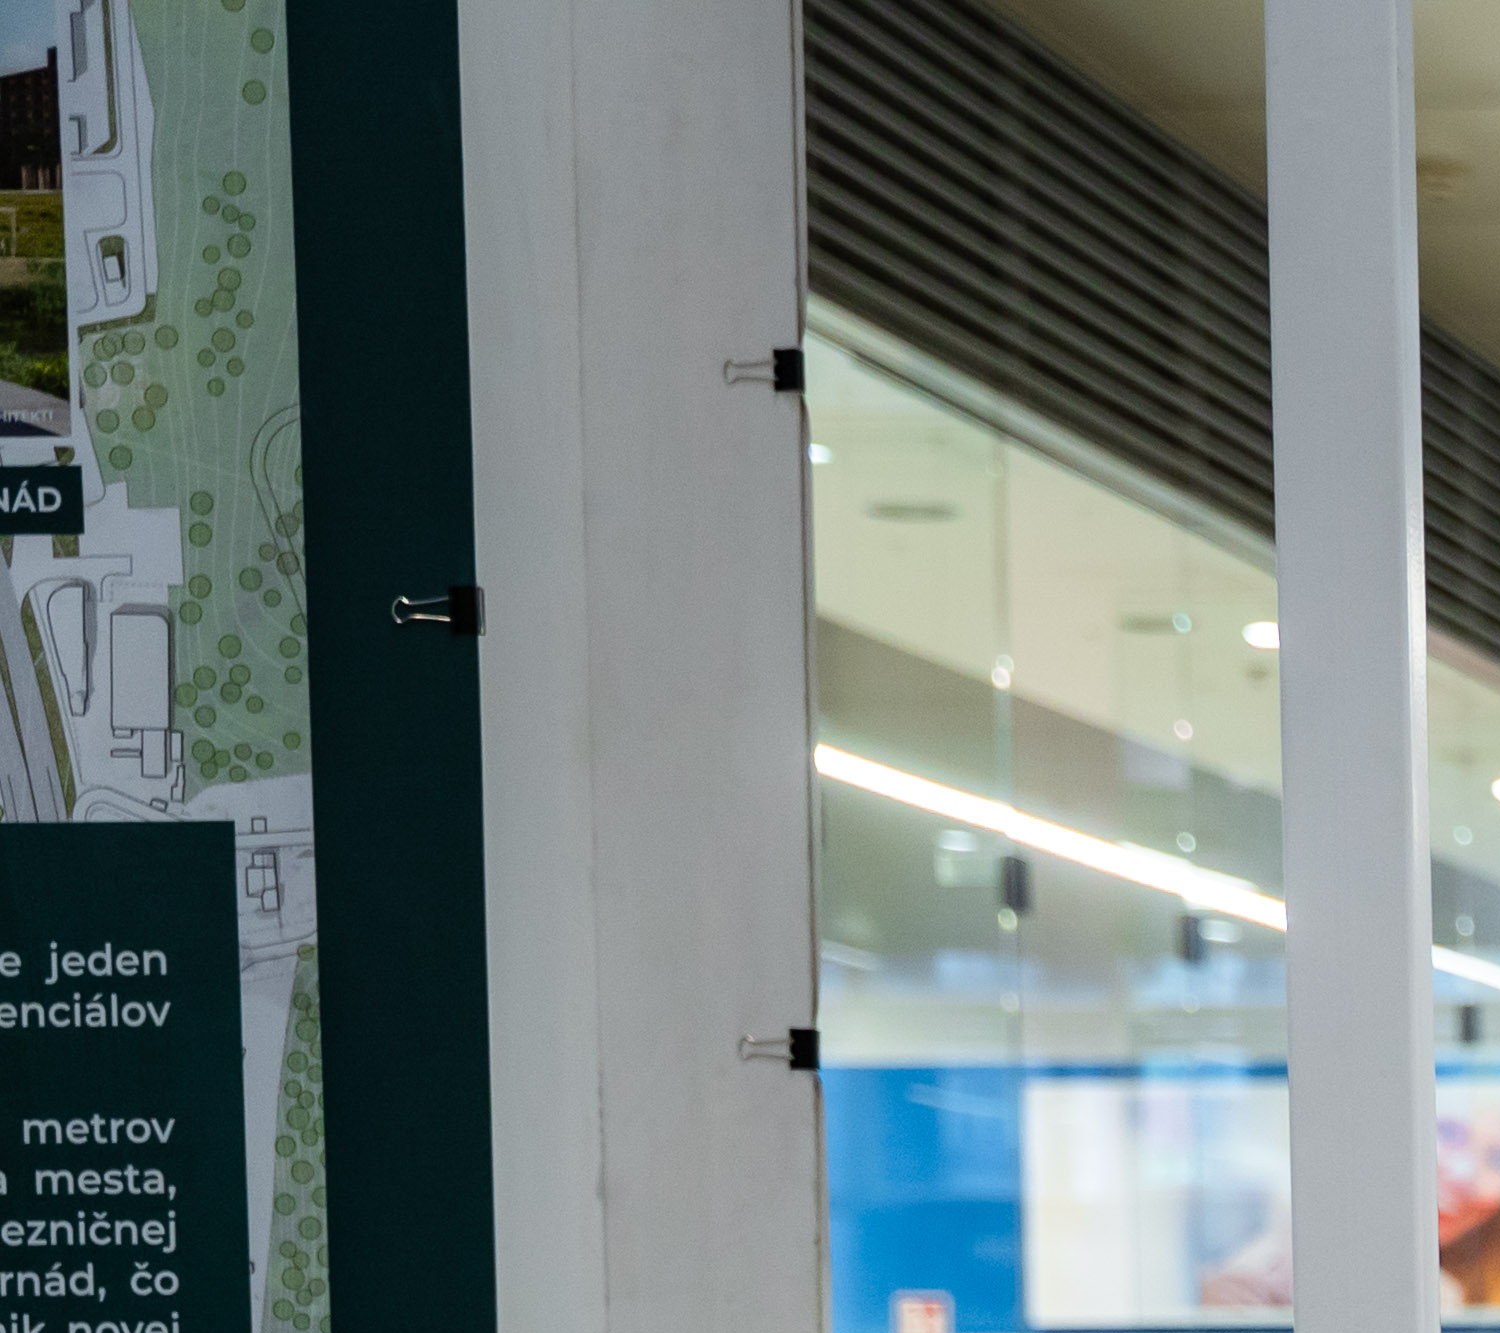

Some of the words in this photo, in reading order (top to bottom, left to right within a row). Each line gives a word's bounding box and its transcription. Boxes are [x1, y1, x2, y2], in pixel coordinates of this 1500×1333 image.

[45, 941, 168, 985] jeden
[0, 992, 171, 1028] enciálov
[23, 1113, 176, 1144] metrov
[35, 1163, 177, 1200] mesta,
[1, 1210, 177, 1253] ezničnej
[0, 1262, 107, 1302] rnád,
[130, 1262, 180, 1296] čo
